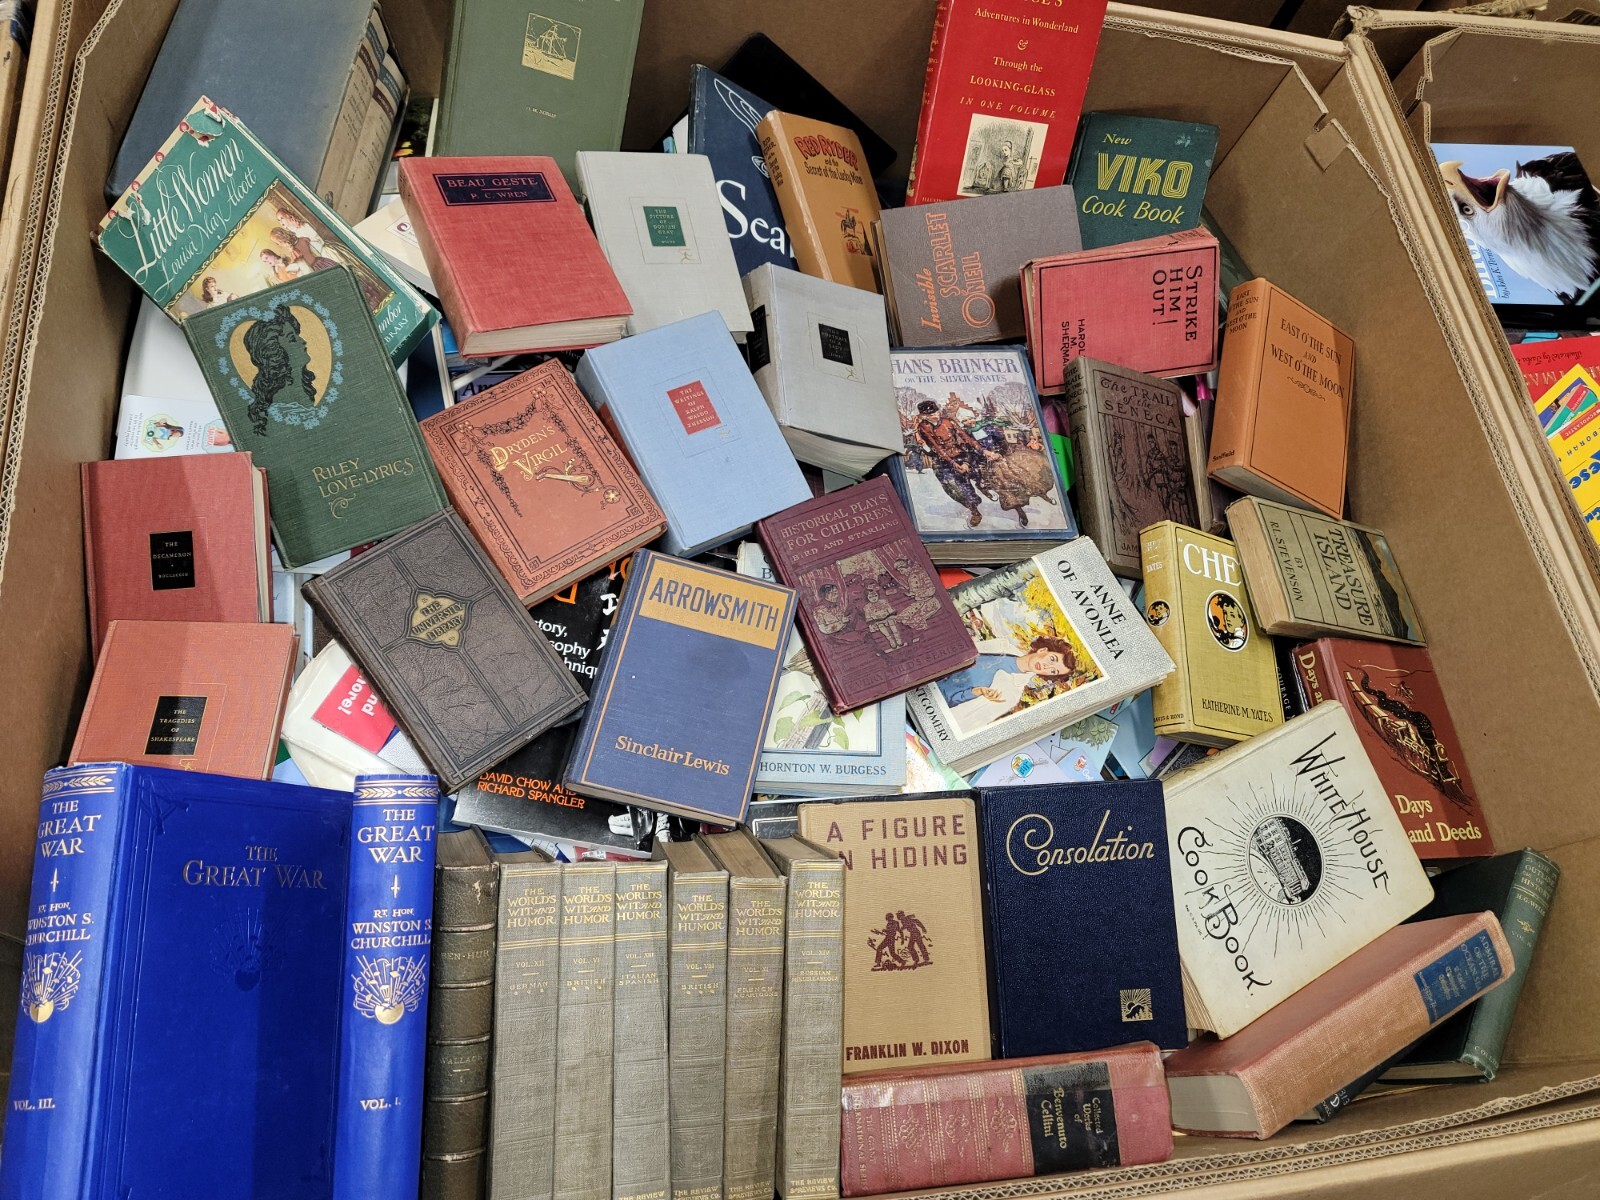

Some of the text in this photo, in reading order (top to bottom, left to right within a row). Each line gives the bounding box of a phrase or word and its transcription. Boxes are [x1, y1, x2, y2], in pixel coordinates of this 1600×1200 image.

[975, 8, 1079, 34] Adventures in Wonderland
[1017, 39, 1029, 51] &
[993, 56, 1043, 73] Through the
[970, 75, 1056, 97] LOOKING-GLASS
[959, 96, 1057, 119] IN ONE VOLUME
[1102, 133, 1132, 146] New
[793, 135, 821, 161] RED
[817, 134, 860, 172] RYDER
[447, 176, 538, 189] BEAU GESTE
[1097, 152, 1194, 199] VIKO
[496, 190, 529, 199] WREN
[119, 137, 245, 285] Little Women
[716, 179, 796, 259] Sea
[1082, 195, 1186, 225] Cook Book
[153, 167, 257, 301] Louisa May Alcott
[926, 212, 960, 298] SCARLET
[917, 267, 942, 332] Invisible
[1169, 267, 1184, 313] HIM
[1236, 290, 1251, 300] EAST
[1245, 296, 1259, 304] SUN
[1185, 265, 1203, 342] STRIKE
[1229, 323, 1248, 334] MOON
[1070, 336, 1078, 350] M.
[1281, 318, 1342, 366] EAST SUN
[891, 358, 1020, 374] HANS BRINKER
[1303, 351, 1317, 364] AND
[916, 375, 937, 383] THE
[939, 375, 971, 383] SILVER
[974, 374, 1007, 382] SKATES
[1271, 343, 1345, 399] WEST MOON
[1100, 377, 1174, 407] The TRAIL
[1123, 395, 1134, 405] of
[1104, 400, 1177, 428] SENECA
[1564, 411, 1597, 437] SCHOLASTIC
[489, 425, 556, 472] DRYDEN'S
[311, 458, 362, 484] RILEY
[512, 444, 568, 481] VIRGIL
[317, 458, 415, 499] LOVE-LYRICS
[781, 493, 889, 539] HISTORICAL PLAYS
[786, 505, 894, 551] FOR CHILDREN
[823, 538, 844, 552] AND
[848, 519, 899, 543] STARLING
[1294, 556, 1304, 571] BY
[1313, 532, 1352, 611] ISLAND
[1328, 528, 1374, 627] TREASURE
[421, 601, 441, 616] THE
[648, 576, 780, 633] ARROWSMITH
[1057, 559, 1125, 660] OF AVONLEA
[1090, 583, 1127, 626] ANNE
[411, 602, 463, 635] UNIVERSITY
[426, 615, 463, 640] LIBRARY
[1299, 650, 1320, 689] Days
[1201, 698, 1274, 723] KATHERINE M. YATES
[615, 735, 731, 777] Sinclair Lewis
[760, 761, 887, 776] HORNTON W. BURGESS
[480, 772, 513, 785] DAVID
[516, 776, 552, 792] CHOW
[477, 781, 526, 799] RICHARD
[527, 789, 586, 810] SPANGLER
[1395, 794, 1433, 818] Days
[52, 801, 80, 814] THE
[383, 808, 416, 822] THE
[38, 814, 102, 835] GREAT
[357, 825, 435, 844] GREAT
[827, 814, 965, 843] A FIGURE
[1407, 819, 1482, 844] and Deeds
[40, 837, 85, 859] WAR
[245, 845, 279, 862] THE
[1006, 809, 1154, 876] Consolation
[368, 846, 425, 864] WAR
[872, 844, 967, 869] HIDING
[182, 859, 328, 890] GREAT WAR
[807, 881, 829, 889] THE
[523, 888, 544, 896] THE
[579, 886, 600, 894] THE
[630, 883, 649, 891] THE
[509, 907, 533, 917] WIT
[564, 904, 588, 914] WIT
[616, 902, 640, 911] WIT
[751, 900, 771, 908] THE
[795, 909, 840, 918] HUMOR
[796, 900, 817, 908] WIT
[82, 912, 95, 925] S.
[507, 916, 555, 928] HUMOR
[564, 913, 609, 925] HUMOR
[616, 910, 661, 922] HUMOR
[678, 913, 701, 921] WIT
[678, 921, 725, 931] HUMOR
[736, 918, 759, 926] WIT
[352, 919, 422, 936] WINSTON
[735, 926, 782, 936] HUMOR
[351, 933, 432, 950] CHURCHILL
[1480, 935, 1499, 978] ADMIRAL
[566, 978, 606, 987] BRITISH
[846, 1039, 969, 1061] FRANKLIN W. DIXON
[14, 1100, 36, 1111] VOL.
[360, 1099, 391, 1111] VOL.
[1092, 1097, 1103, 1134] Collected
[1041, 1099, 1054, 1137] Cellini
[1053, 1087, 1067, 1149] Benvenuto
[1082, 1103, 1093, 1131] Works
